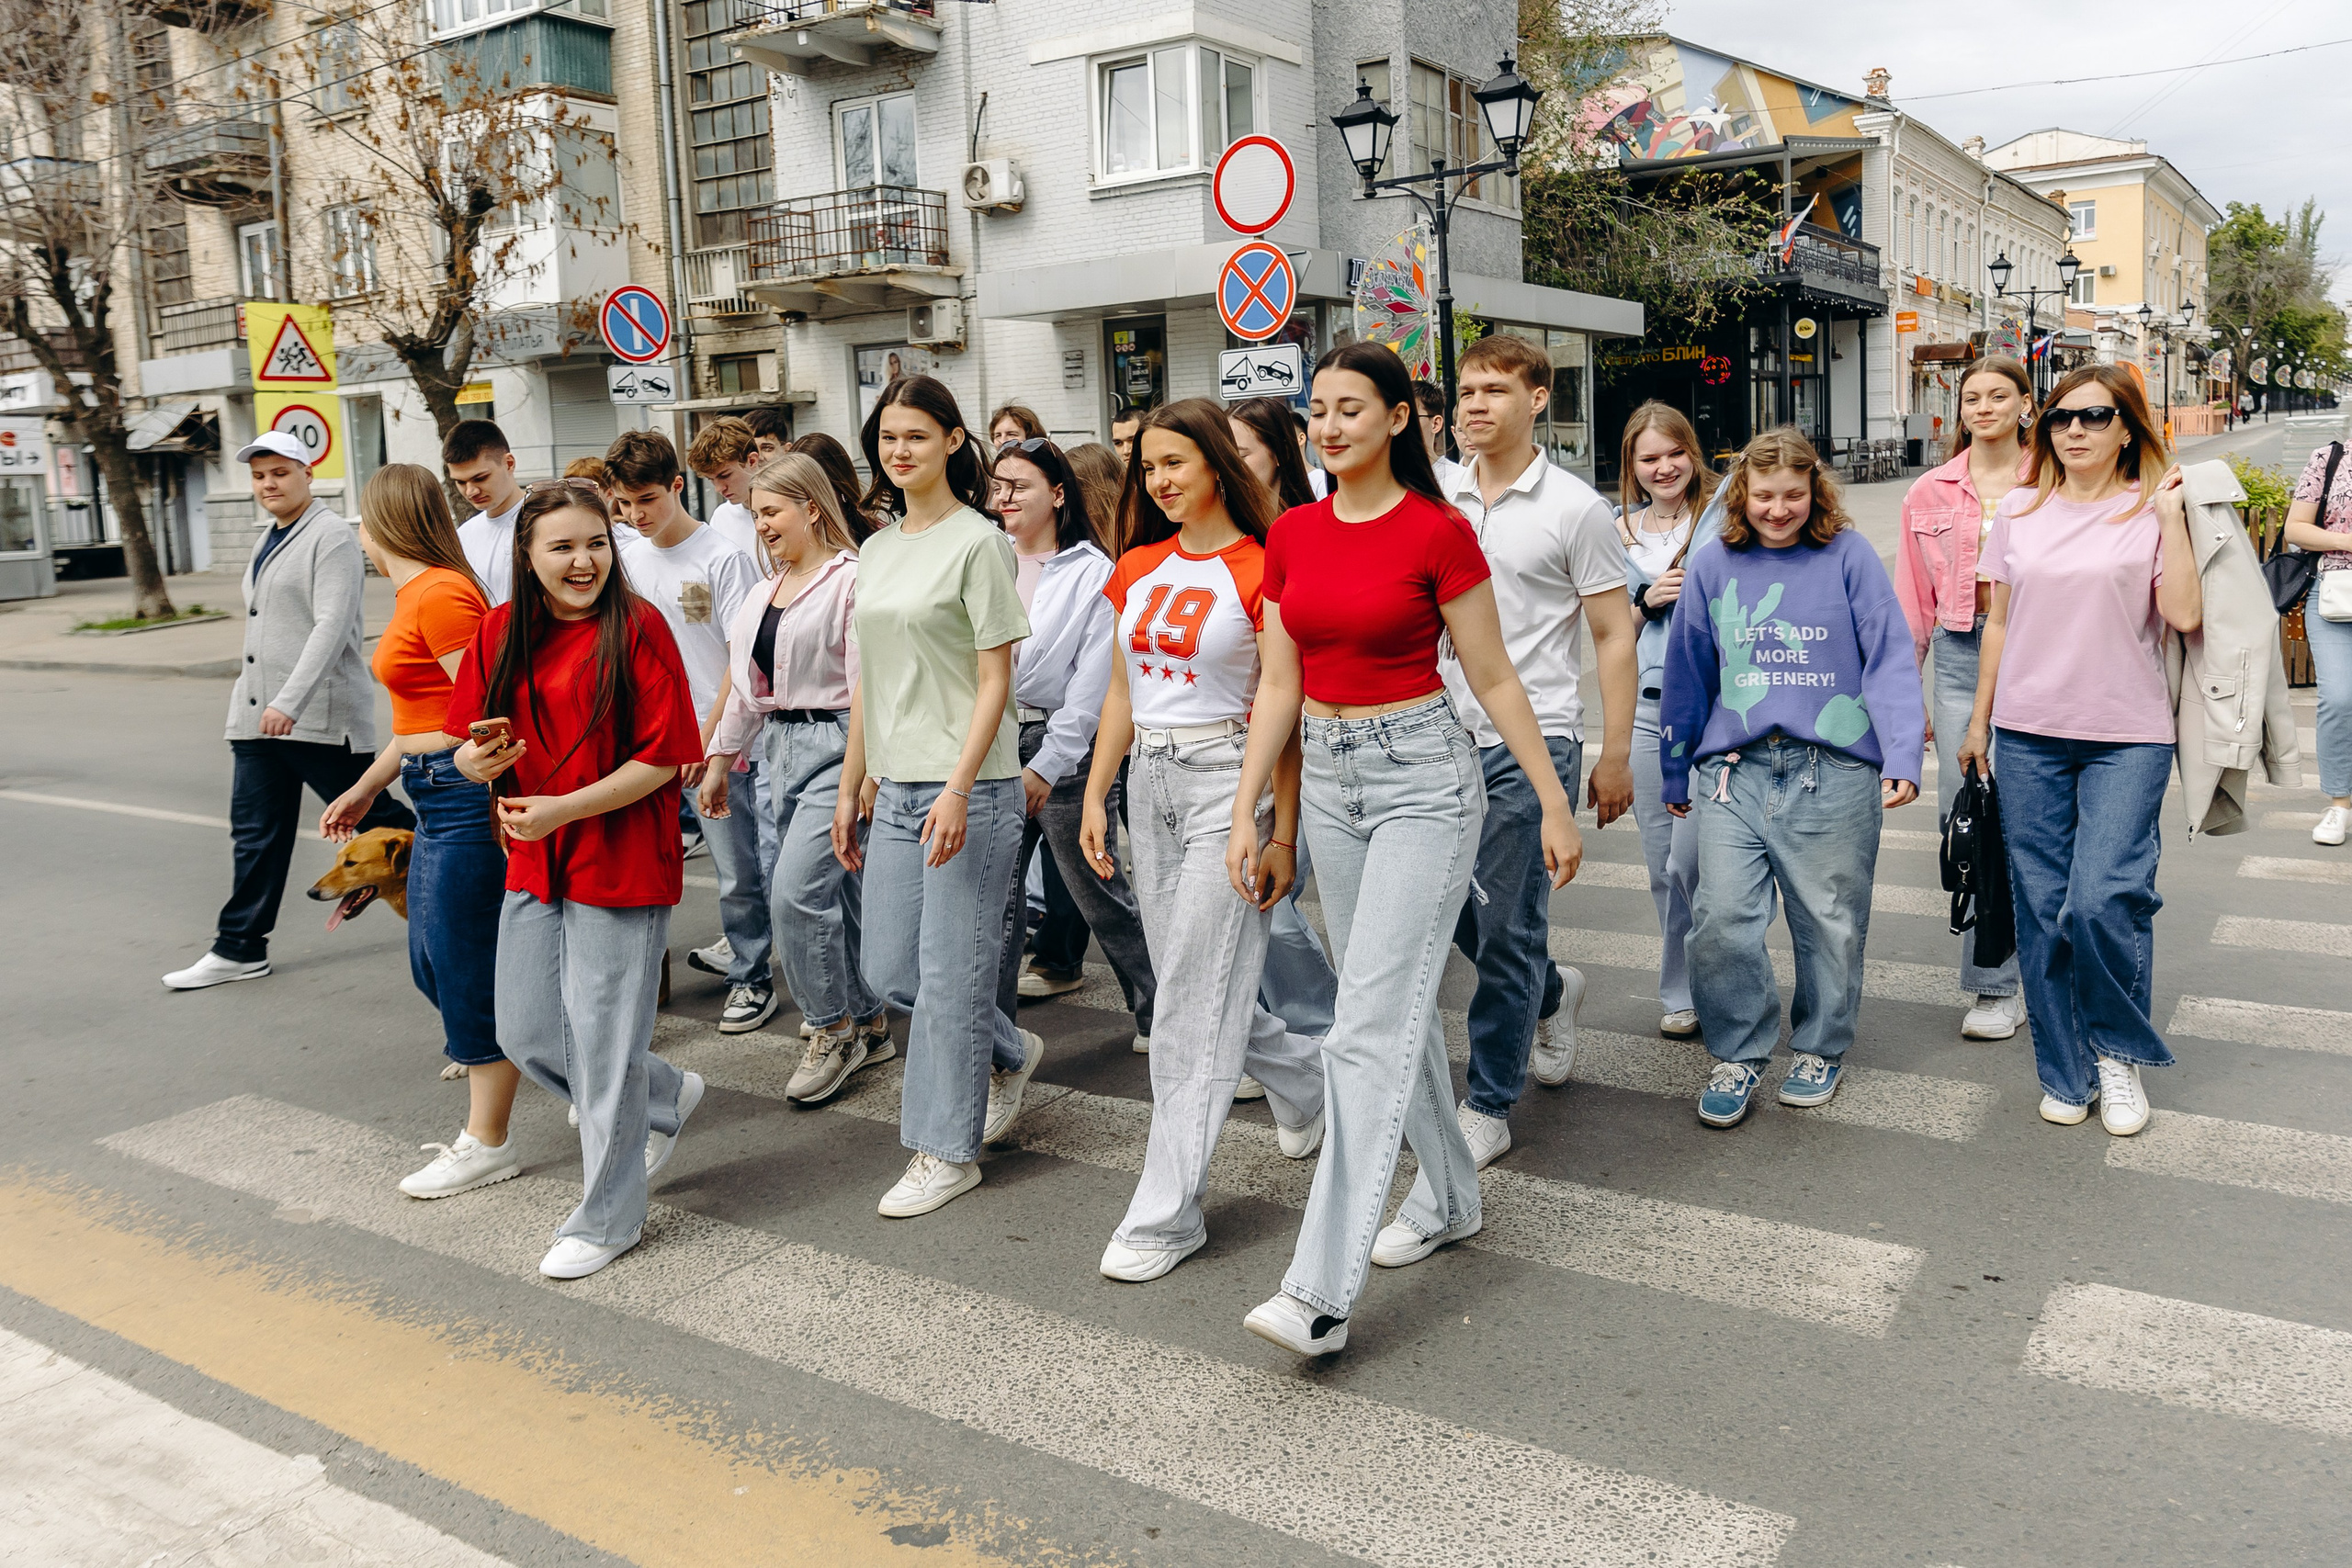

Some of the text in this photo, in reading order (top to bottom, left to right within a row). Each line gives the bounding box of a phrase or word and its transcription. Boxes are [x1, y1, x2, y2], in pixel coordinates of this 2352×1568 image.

[1662, 344, 1706, 362] БЛИН
[1128, 583, 1217, 661] 19
[1734, 626, 1828, 642] LET'S ADD
[1756, 649, 1809, 664] MORE
[1734, 671, 1836, 688] GREENERY!
